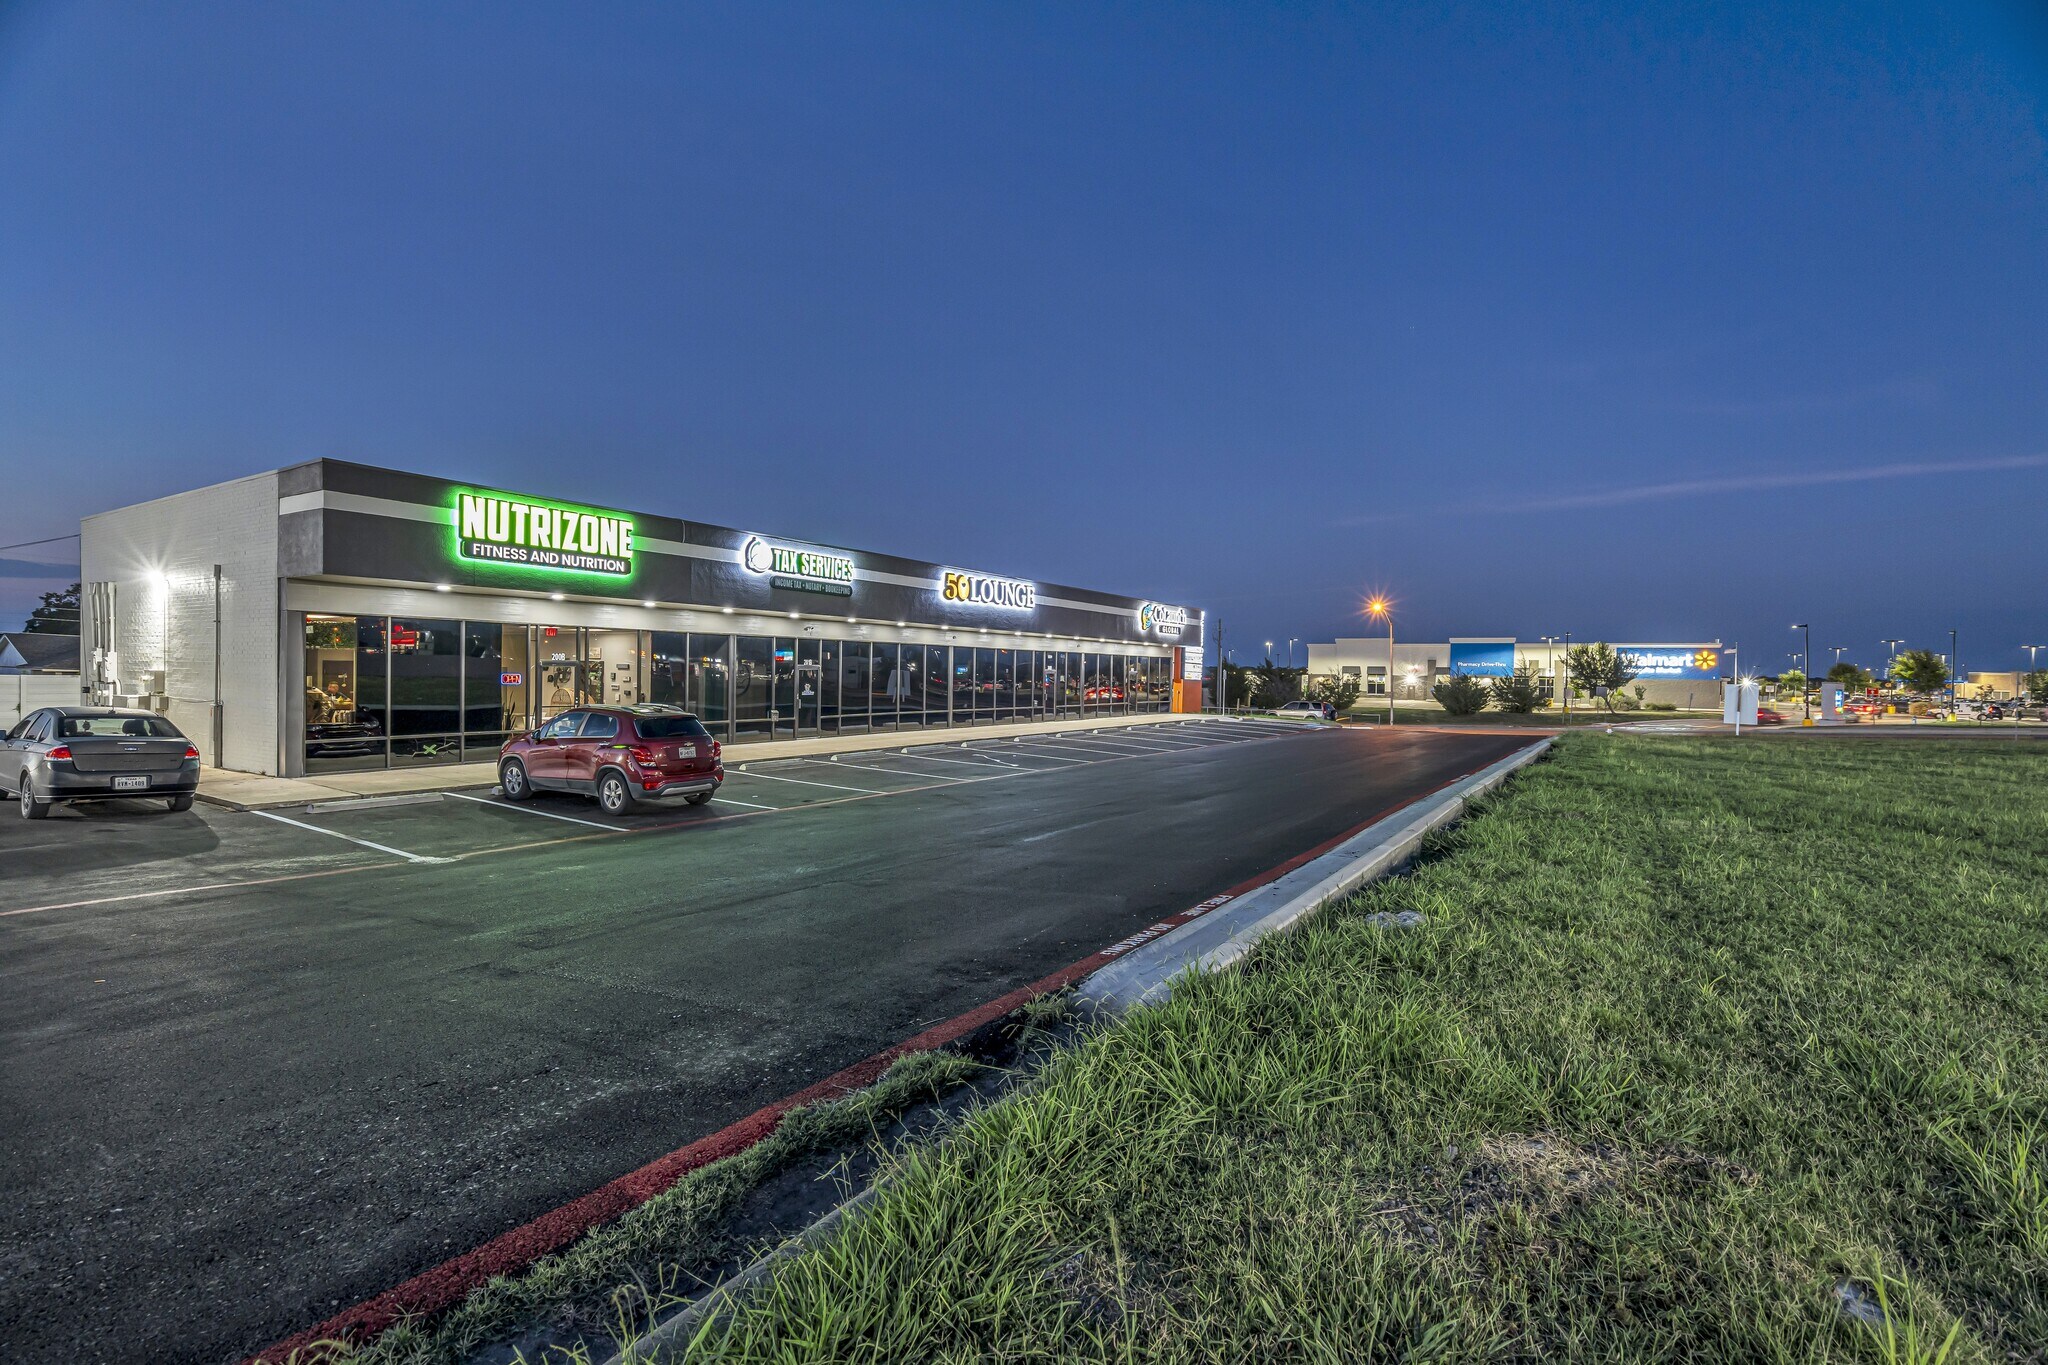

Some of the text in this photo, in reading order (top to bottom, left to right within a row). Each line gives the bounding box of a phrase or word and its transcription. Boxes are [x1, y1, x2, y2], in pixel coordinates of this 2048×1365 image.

[463, 495, 633, 558] NUTRIZONE
[473, 543, 625, 572] FITNESS AND NUTRITION
[773, 549, 855, 581] TAX SERVICES
[774, 578, 793, 588] INCOME
[805, 581, 822, 591] NOTARY
[969, 577, 1036, 608] LOUNGE
[502, 674, 520, 684] OPEN
